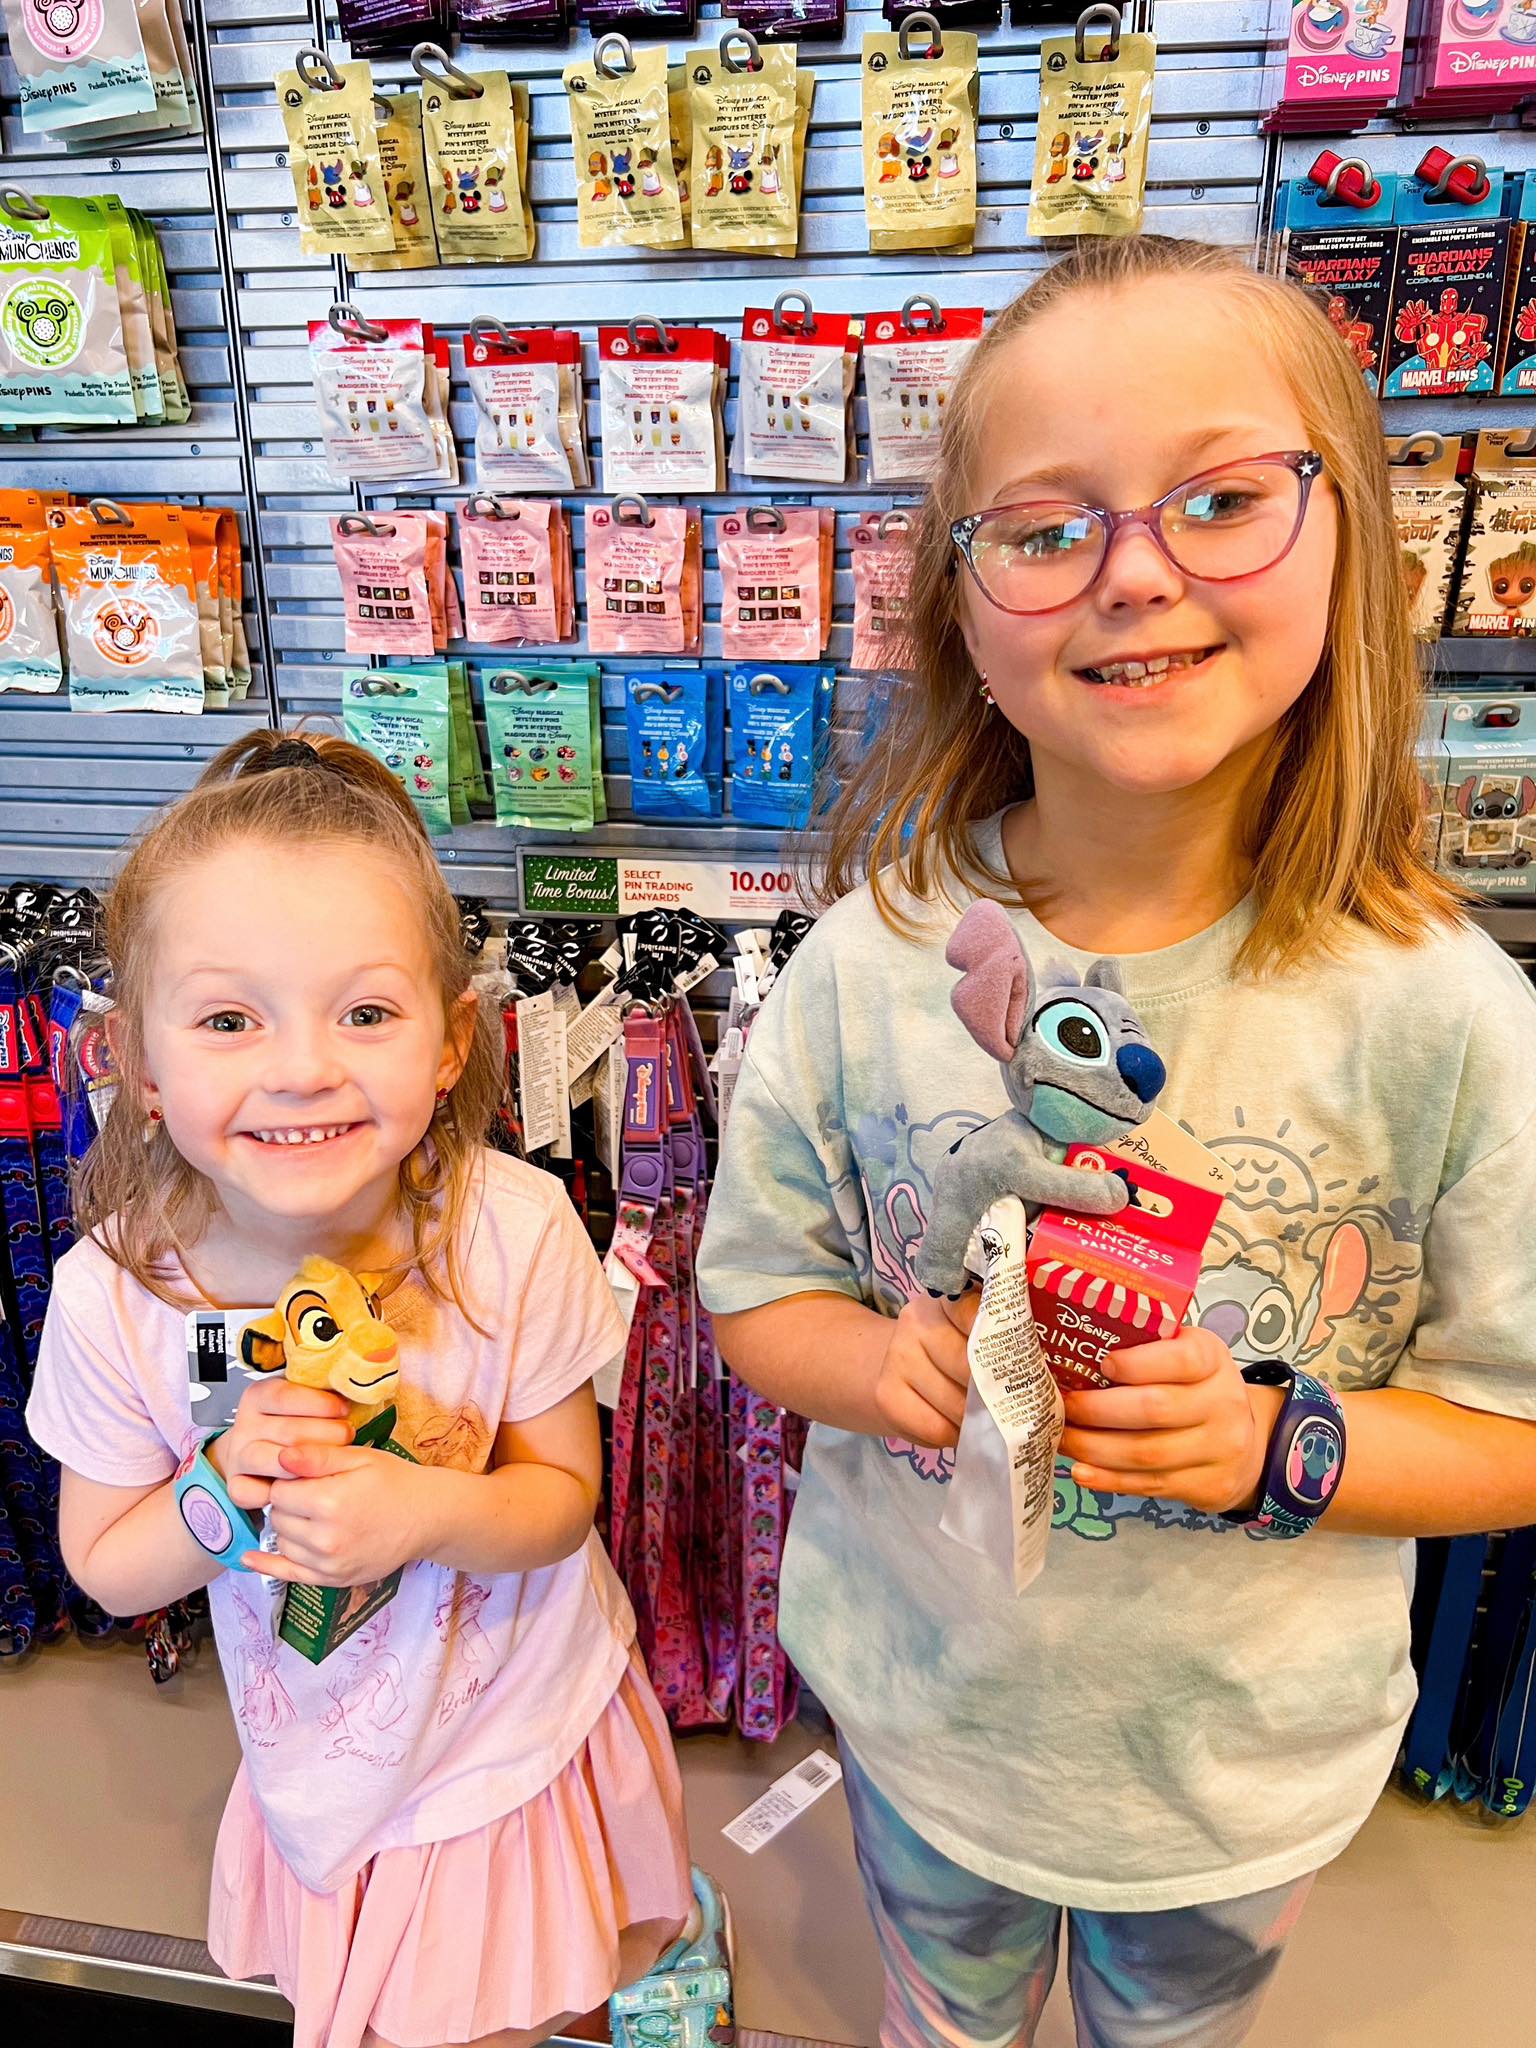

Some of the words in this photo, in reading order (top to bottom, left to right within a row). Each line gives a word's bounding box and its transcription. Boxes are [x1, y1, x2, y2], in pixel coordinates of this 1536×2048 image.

[1095, 83, 1125, 91] MAGICAL
[1412, 236, 1441, 244] ENSEMBLE
[1408, 247, 1494, 265] GUARDIANS
[1426, 259, 1488, 275] GALAXY
[1314, 269, 1376, 282] GALAXY
[1406, 276, 1444, 285] COSMIC
[1447, 272, 1485, 282] REWIND
[1401, 369, 1443, 388] MARVEL
[1446, 369, 1479, 383] PINS
[1469, 615, 1510, 630] MARVEL
[545, 866, 597, 882] Limited
[624, 870, 662, 879] SELECT
[730, 872, 792, 892] 10.00
[533, 883, 563, 899] Time
[565, 884, 617, 901] Bonus!
[624, 882, 642, 891] PIN
[644, 882, 693, 892] TRADING
[625, 893, 680, 903] LANYARDS
[1208, 1167, 1224, 1181] 3+
[1063, 1216, 1174, 1266] PRINCESS
[1081, 1239, 1149, 1270] PASTRIES
[1056, 1303, 1121, 1348] Disney
[216, 1328, 225, 1353] Magnet
[1034, 1321, 1111, 1363] RINCE
[1043, 1352, 1110, 1388] ASTRIES
